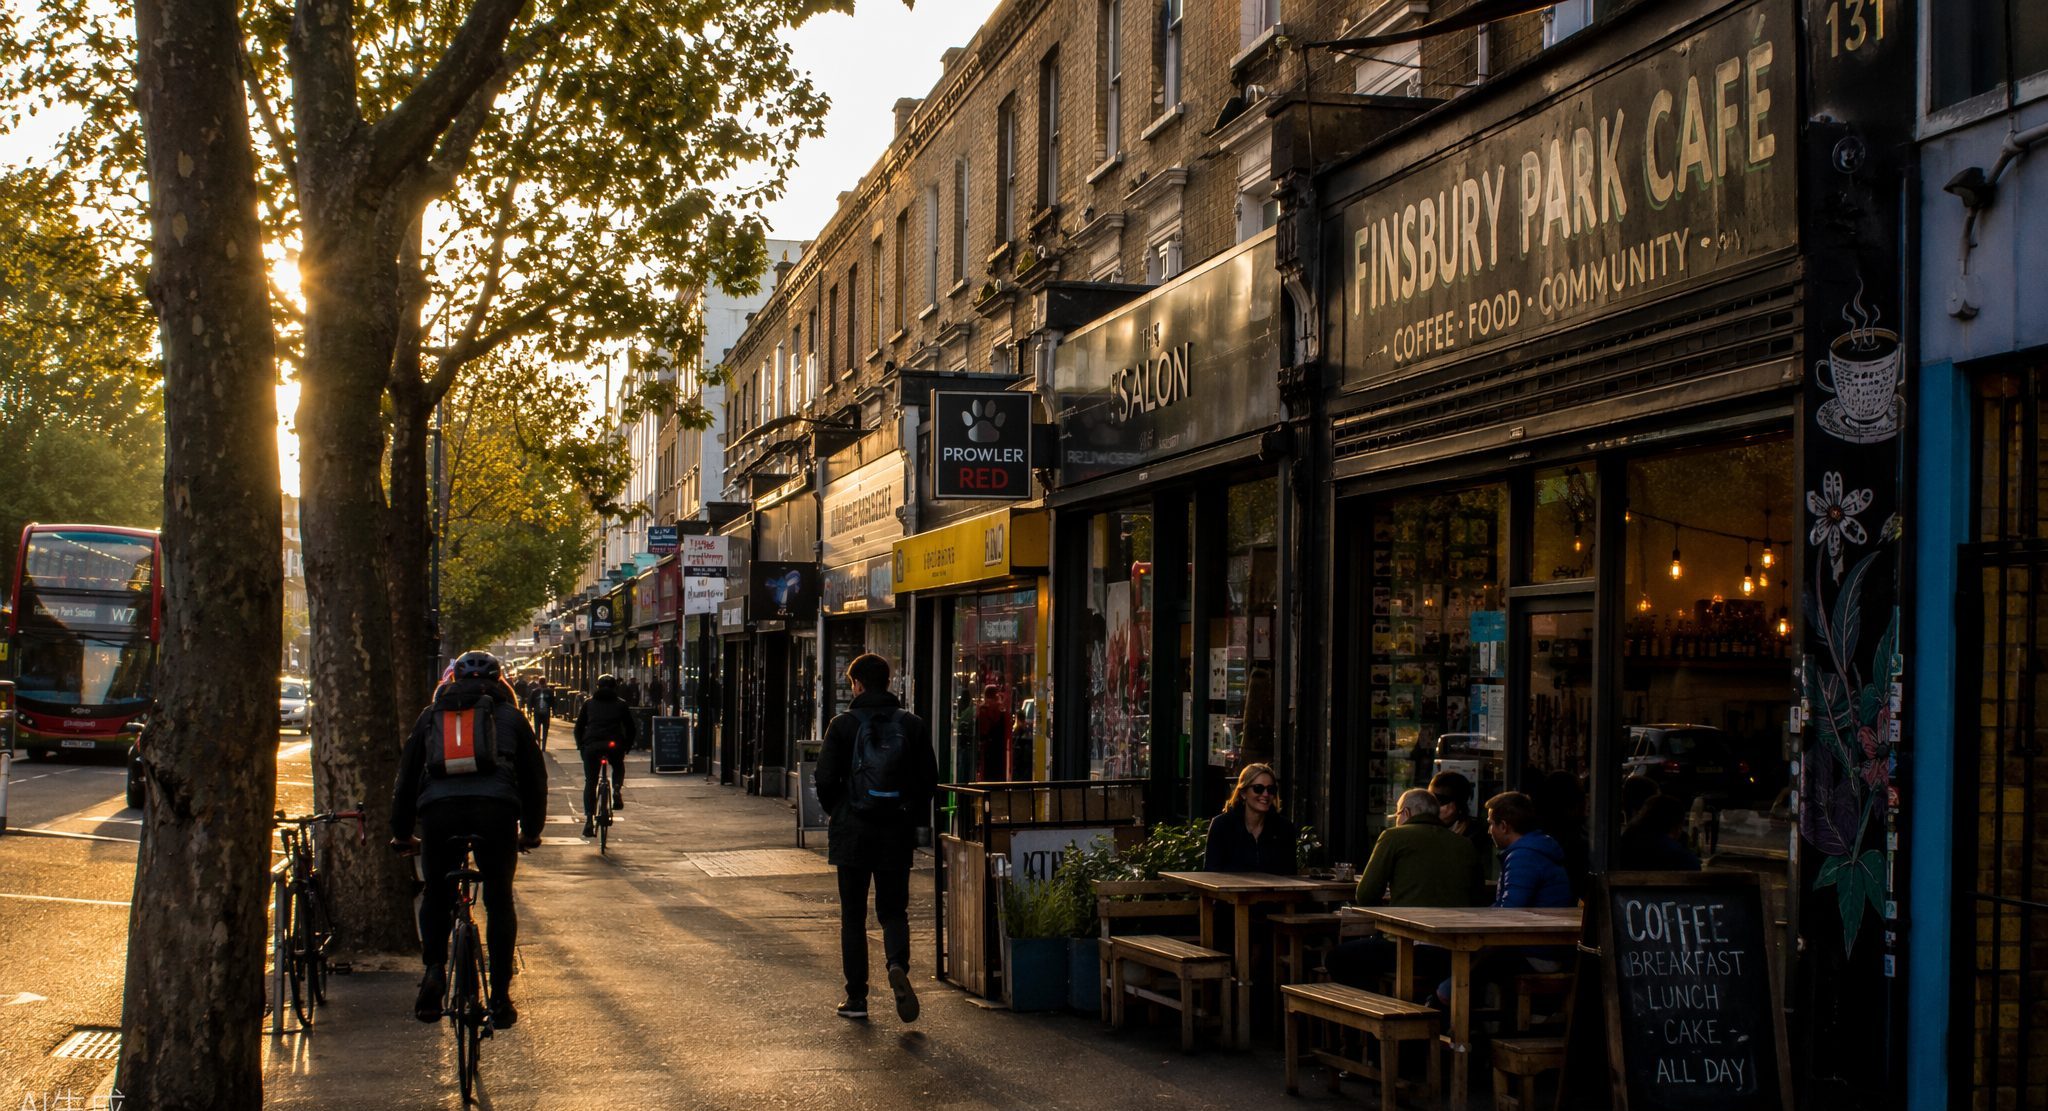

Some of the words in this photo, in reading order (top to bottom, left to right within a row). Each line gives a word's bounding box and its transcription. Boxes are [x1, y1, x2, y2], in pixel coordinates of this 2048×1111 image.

[1826, 0, 1884, 58] 131
[1354, 164, 1506, 316] FINSBURY
[1521, 108, 1628, 254] PARK
[1647, 14, 1776, 202] CAFÉ
[1394, 310, 1454, 363] COFFEE
[1469, 290, 1521, 339] FOOD
[1541, 227, 1690, 316] COMMUNITY
[1119, 342, 1190, 422] SALON
[943, 447, 1024, 462] PROWLER
[960, 466, 1009, 489] RED
[111, 607, 137, 623] W7
[1626, 900, 1729, 943] COFFEE
[1629, 951, 1745, 977] BREAKFAST
[1648, 984, 1719, 1010] LUNCH
[1656, 1058, 1697, 1083] ALL
[1704, 1058, 1745, 1091] DAY
